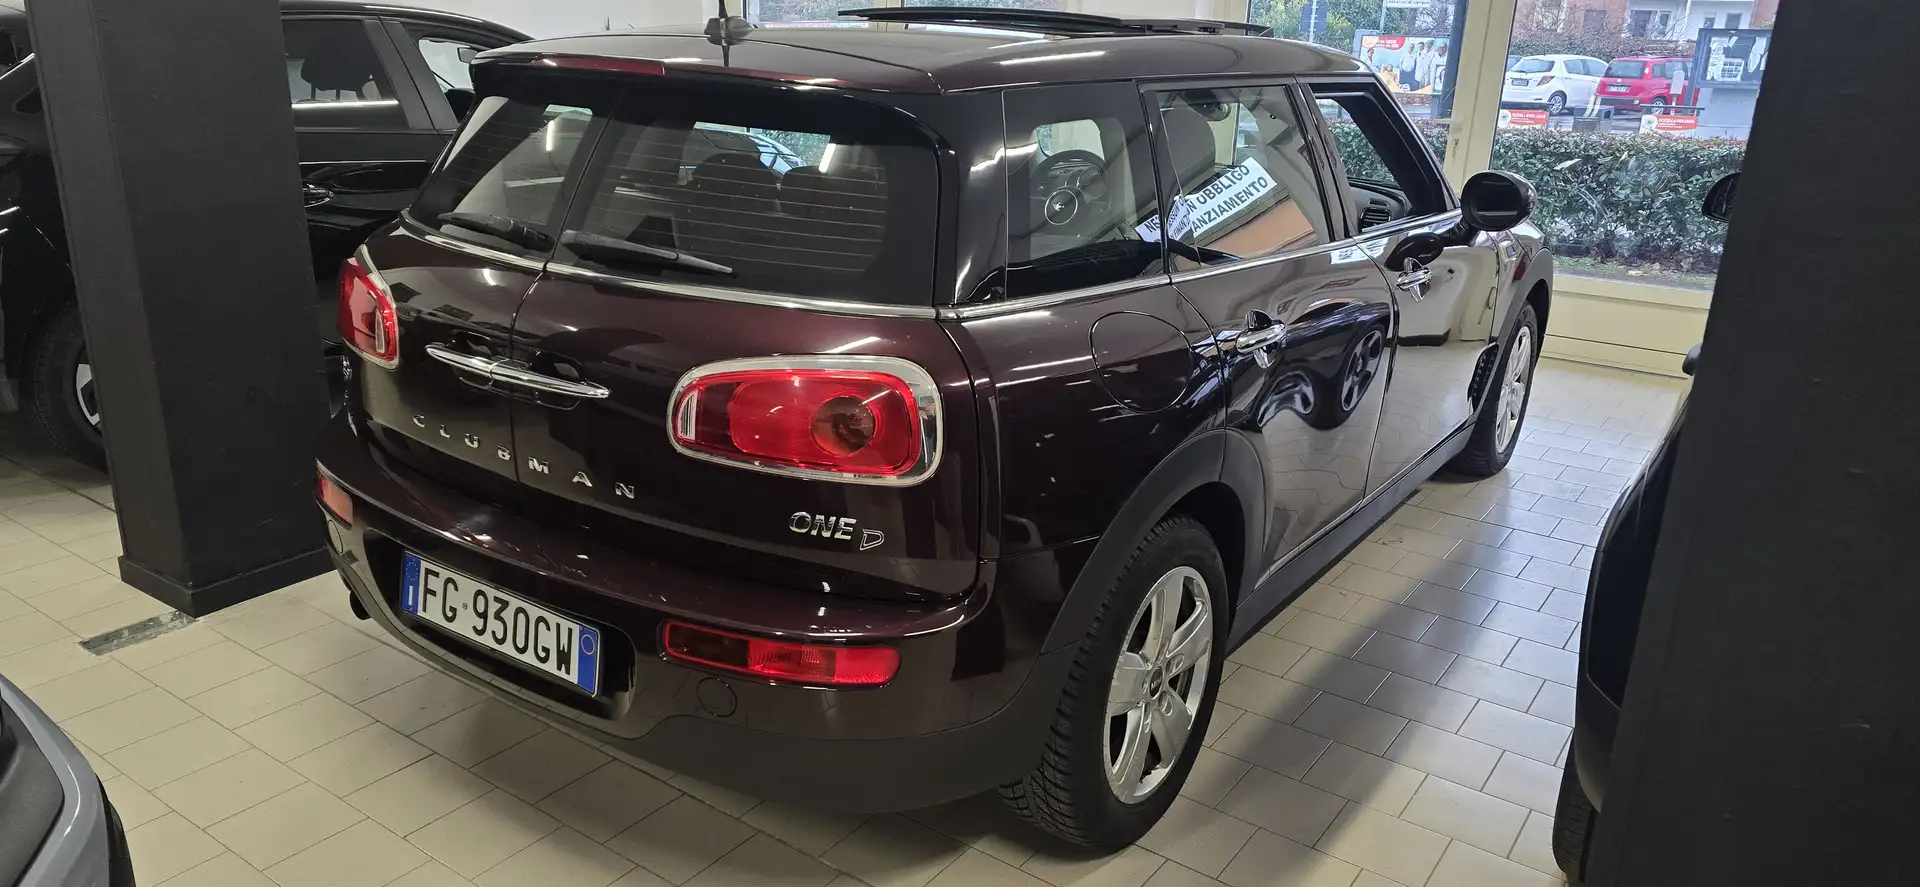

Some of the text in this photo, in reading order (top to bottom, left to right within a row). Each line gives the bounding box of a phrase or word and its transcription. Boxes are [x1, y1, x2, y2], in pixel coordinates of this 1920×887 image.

[1191, 176, 1268, 232] ANZIAMENTO
[412, 414, 635, 500] CLUBMAN
[788, 511, 885, 551] ONE D
[421, 566, 573, 676] FG 930GW
